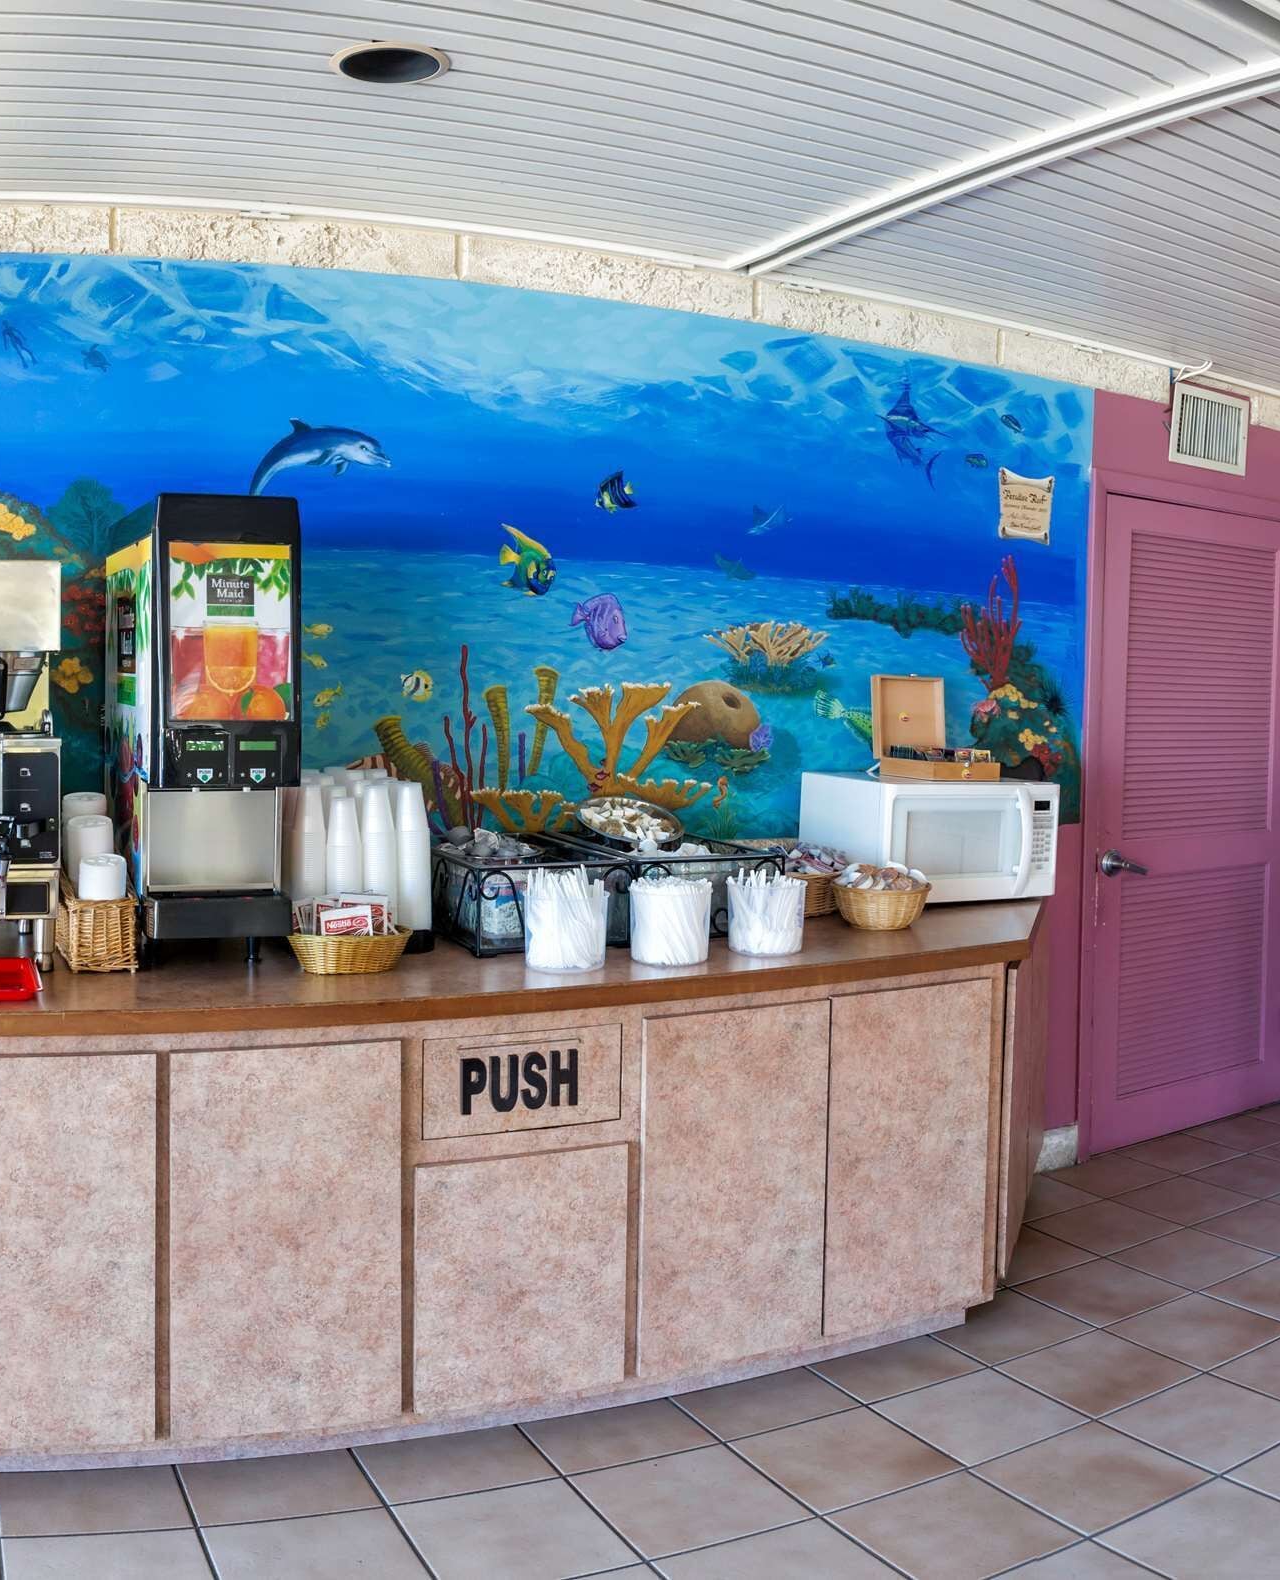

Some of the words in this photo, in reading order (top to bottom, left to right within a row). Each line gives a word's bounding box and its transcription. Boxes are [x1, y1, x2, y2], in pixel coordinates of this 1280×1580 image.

[211, 578, 250, 589] Minute
[216, 588, 245, 599] Maid
[460, 1048, 579, 1115] PUSH
